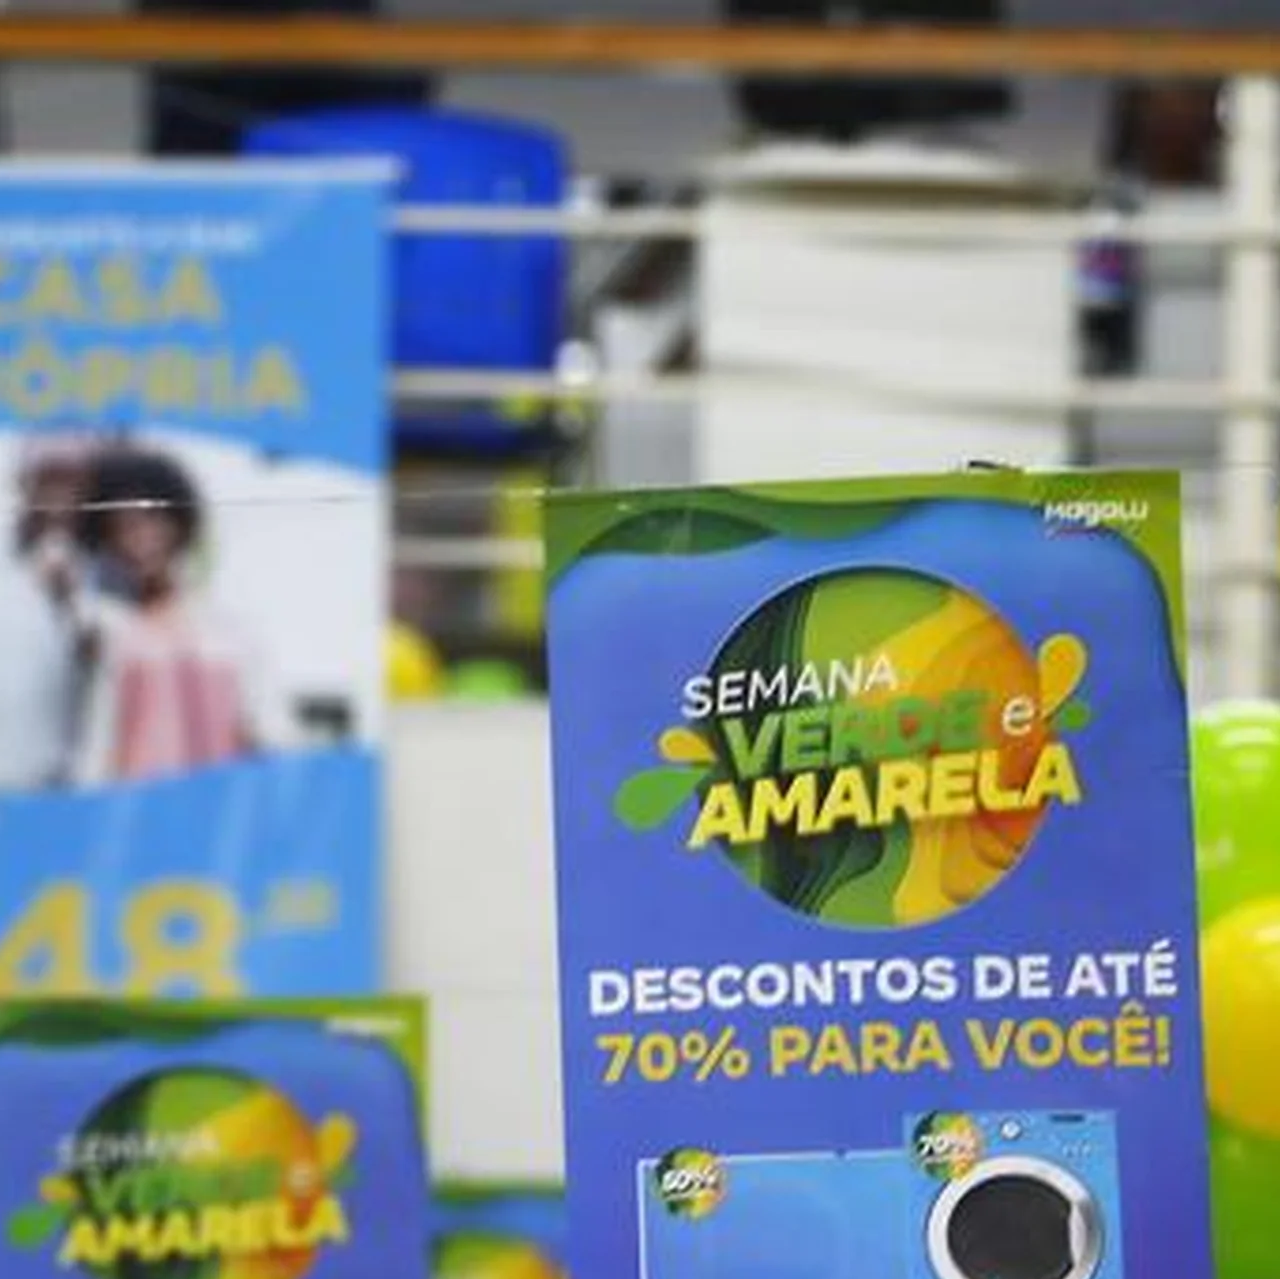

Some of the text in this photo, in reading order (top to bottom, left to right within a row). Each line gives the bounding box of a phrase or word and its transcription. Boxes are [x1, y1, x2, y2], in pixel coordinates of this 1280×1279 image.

[681, 653, 899, 719] SEMANA
[723, 690, 1035, 777] VERDE e
[686, 743, 1082, 849] AMARELA
[589, 940, 1178, 1015] DESCONTOS DE ATÉ
[597, 1002, 1171, 1083] 70% PARA VOCÊ!
